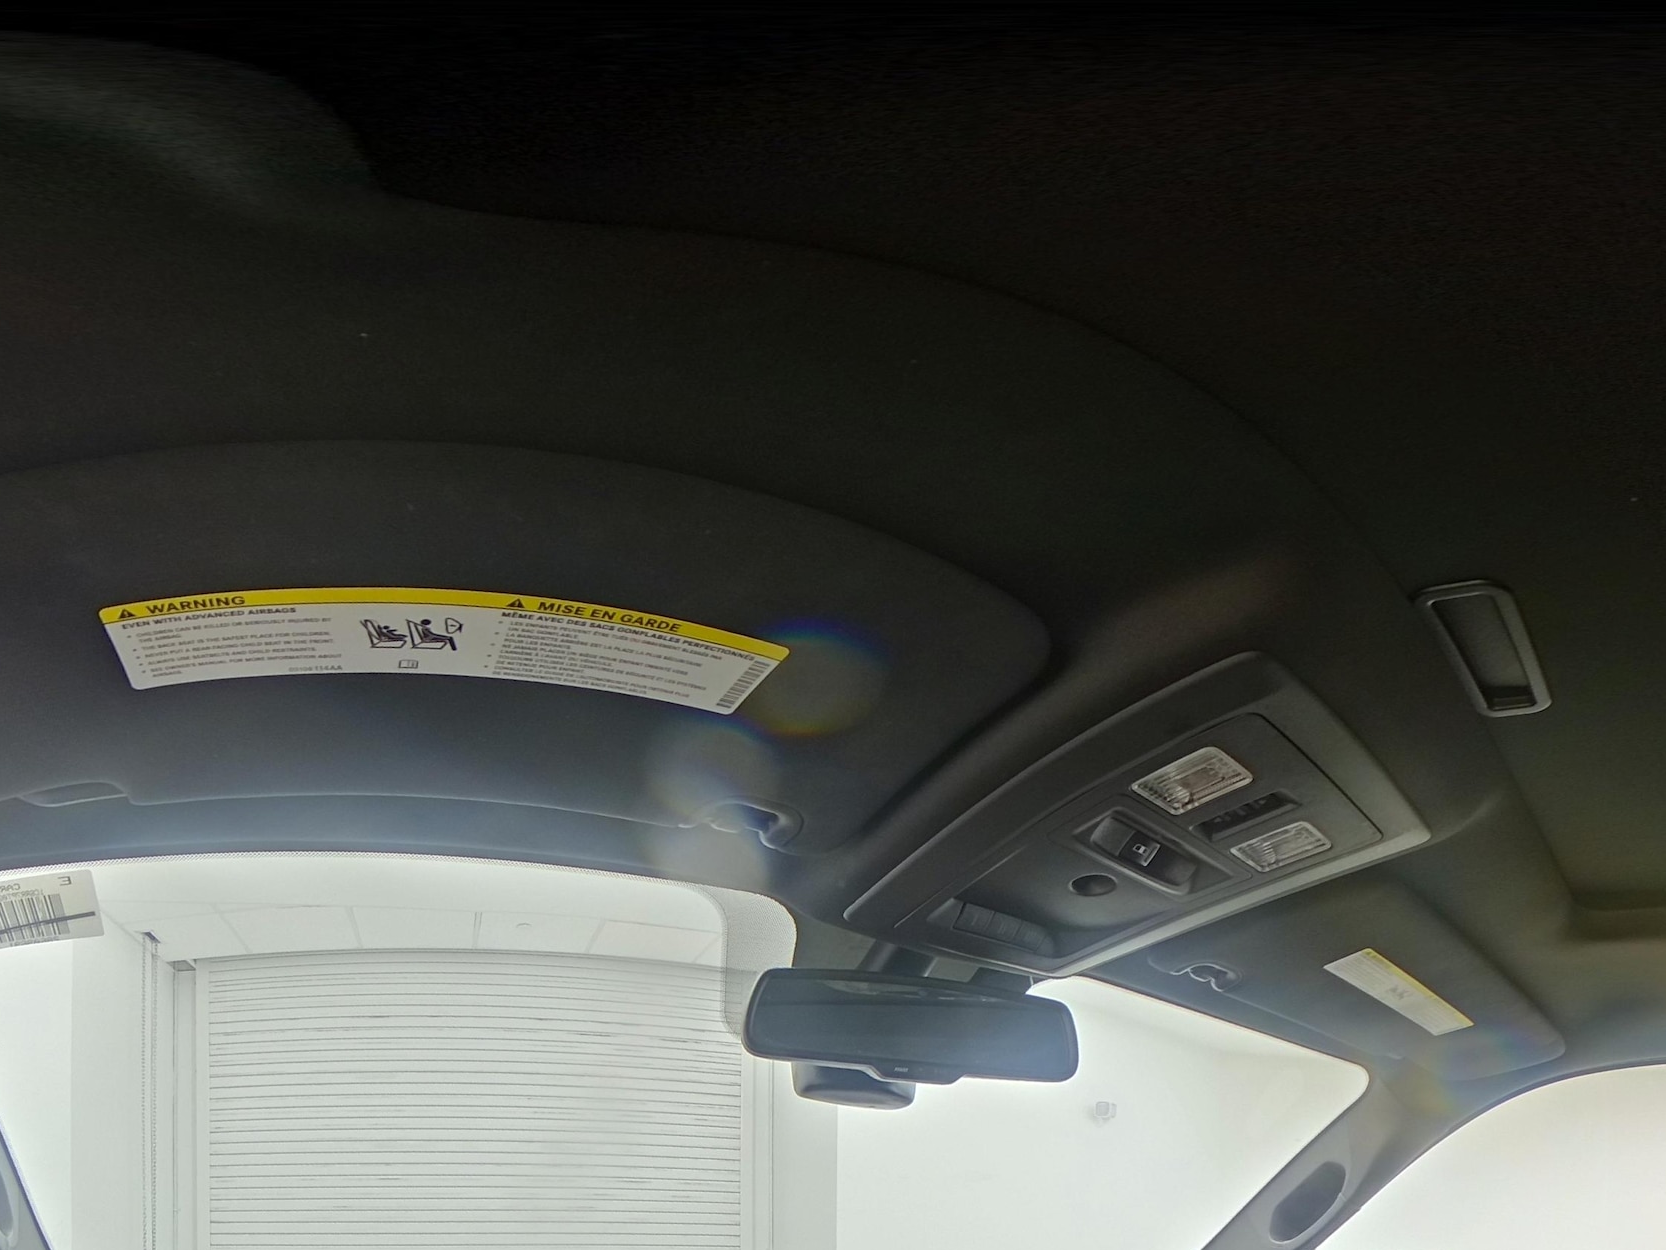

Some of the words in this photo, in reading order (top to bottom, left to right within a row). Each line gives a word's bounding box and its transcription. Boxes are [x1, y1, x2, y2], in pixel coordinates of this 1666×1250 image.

[122, 621, 150, 629] EVEN
[152, 617, 182, 625] WITH
[185, 610, 245, 621] ADVANCED
[248, 607, 297, 615] AIRBAGS
[146, 596, 245, 614] WARNING
[537, 601, 587, 616] MISE
[589, 608, 616, 620] EN
[620, 612, 682, 633] GARDE
[501, 611, 535, 620] MÊME
[536, 615, 564, 624] AVEC
[566, 619, 586, 627] DES
[588, 622, 614, 632] SACS
[617, 626, 681, 644] GONFLABLES
[682, 639, 756, 661] PERFECTIONNÉS
